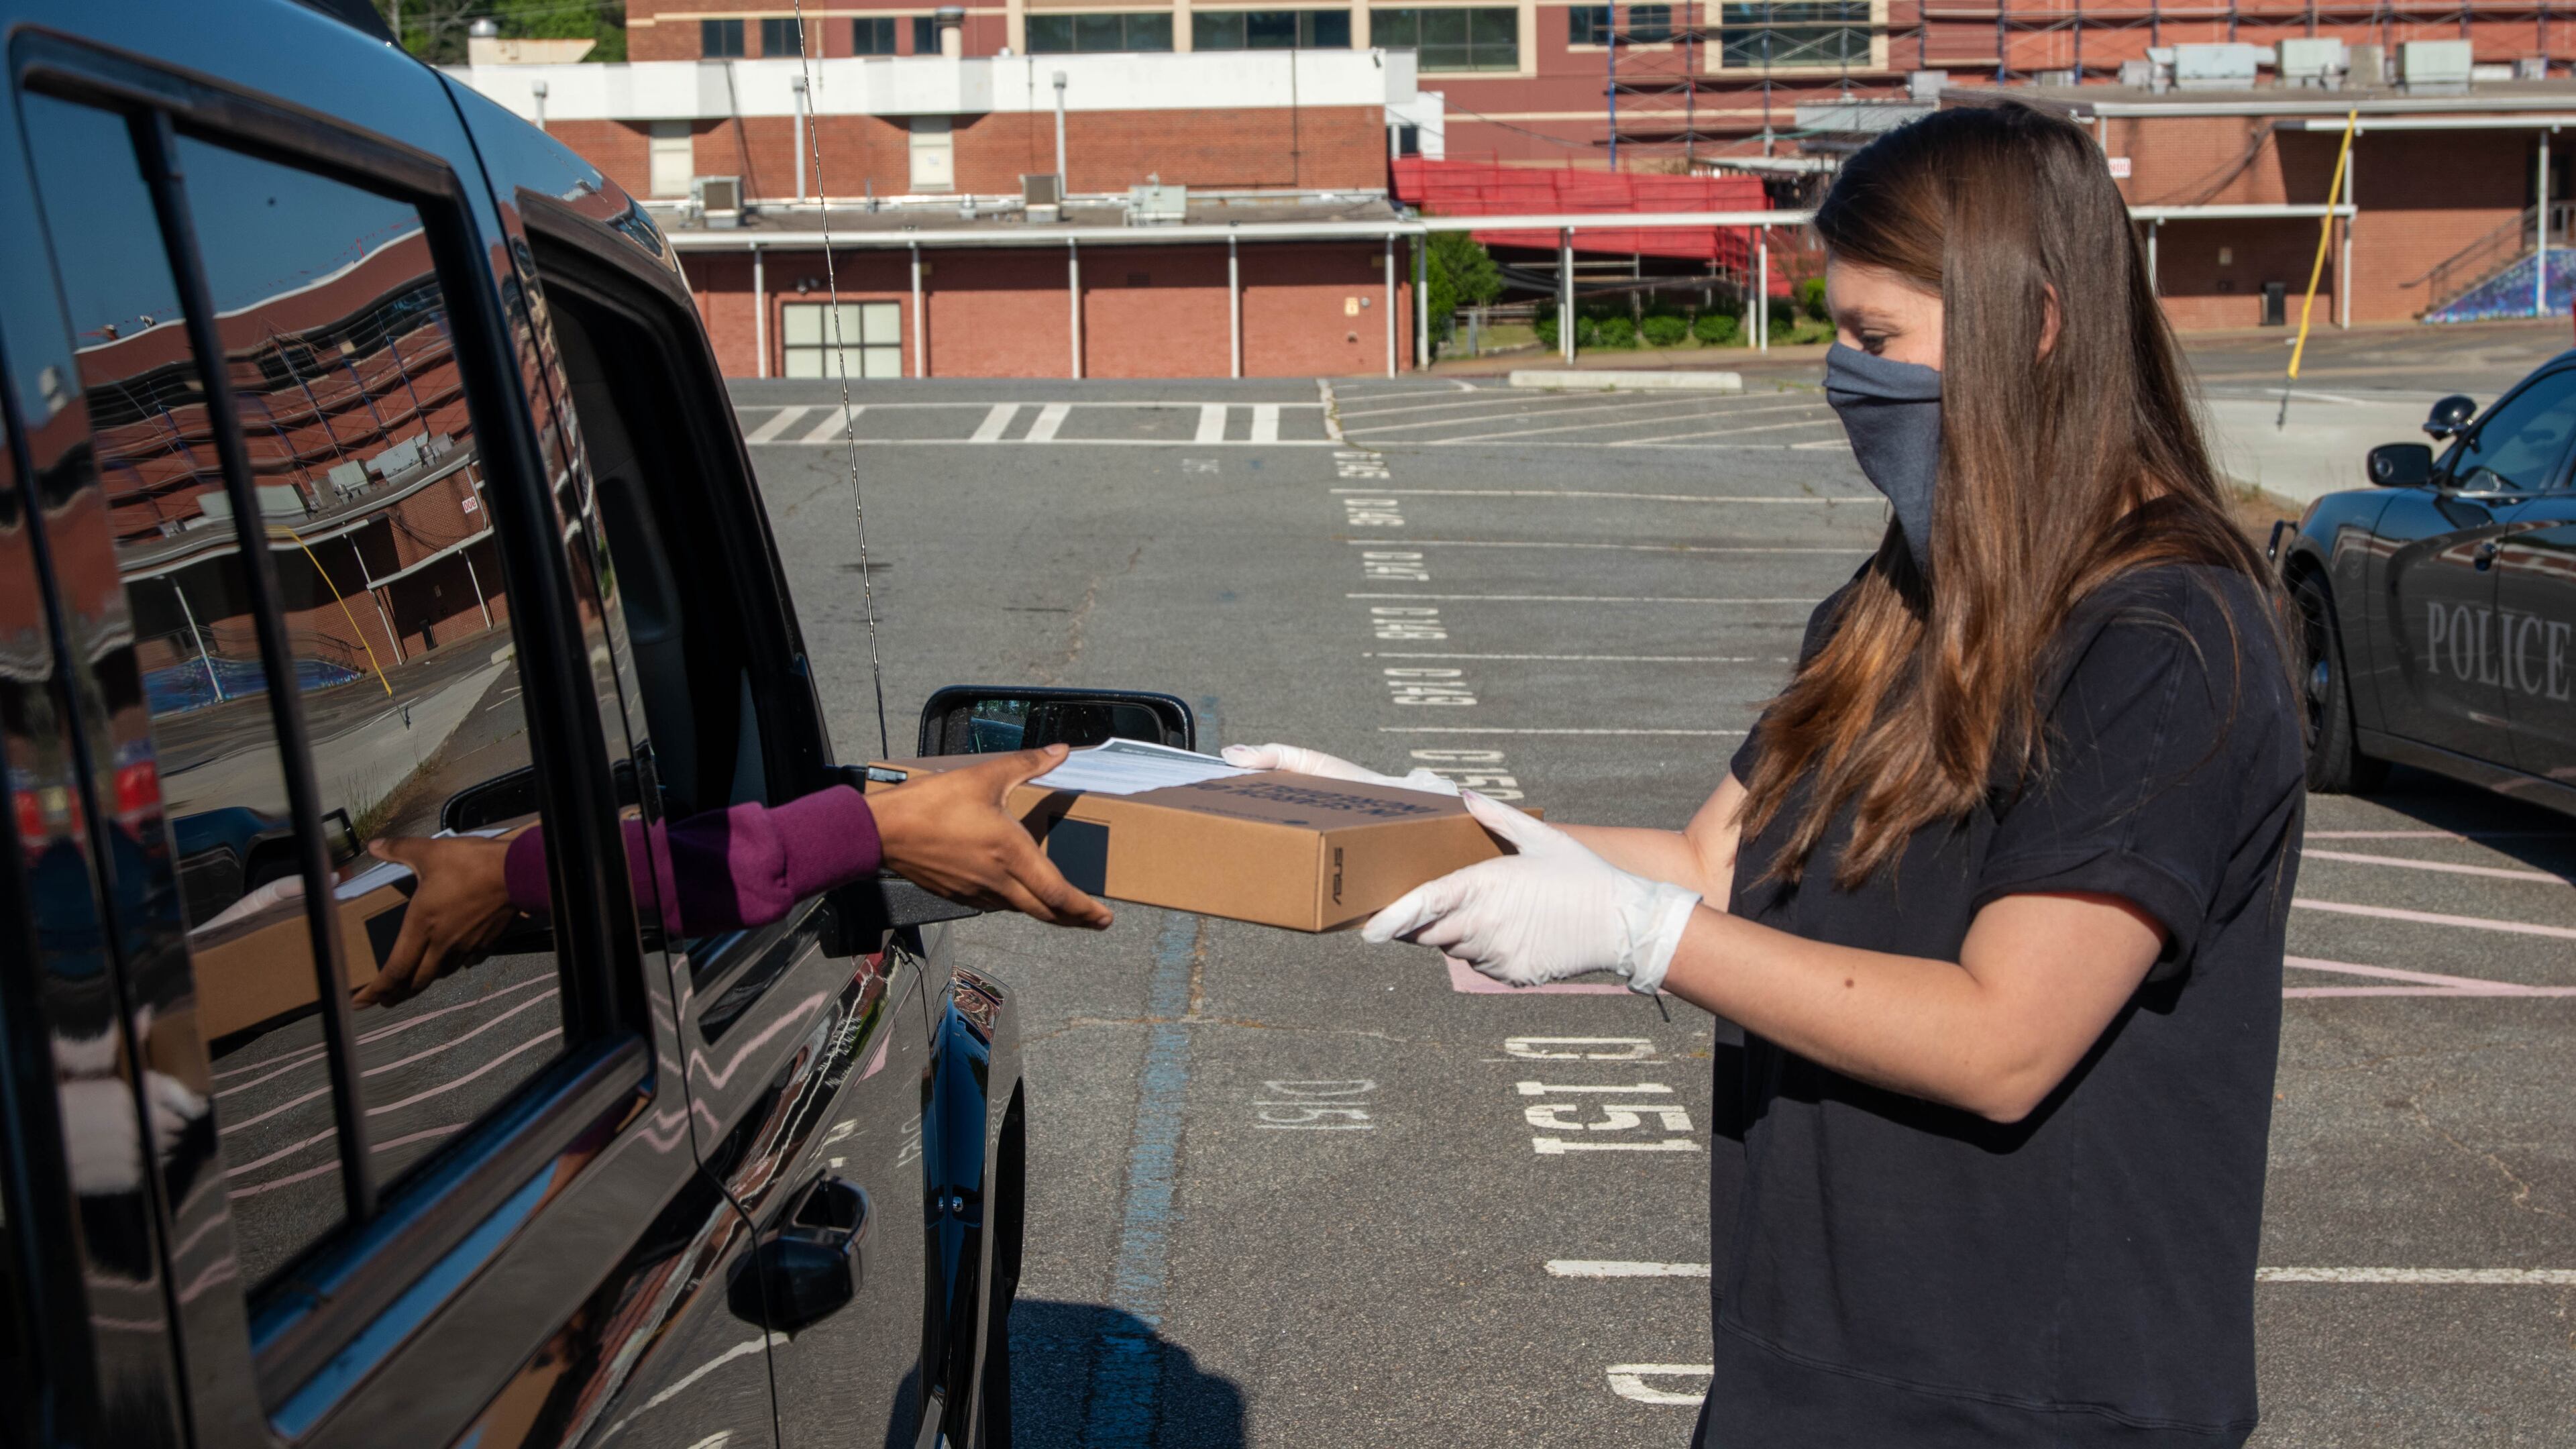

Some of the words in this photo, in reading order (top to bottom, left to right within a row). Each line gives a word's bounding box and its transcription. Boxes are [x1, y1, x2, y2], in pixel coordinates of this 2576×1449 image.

[1362, 551, 1430, 581] D147
[1371, 607, 1448, 639] D148
[2427, 602, 2571, 702] POLICE
[1384, 668, 1478, 705] D149
[1333, 847, 1342, 905] ASUS
[1254, 1079, 1377, 1131] D151
[1504, 1036, 1703, 1155] D151
